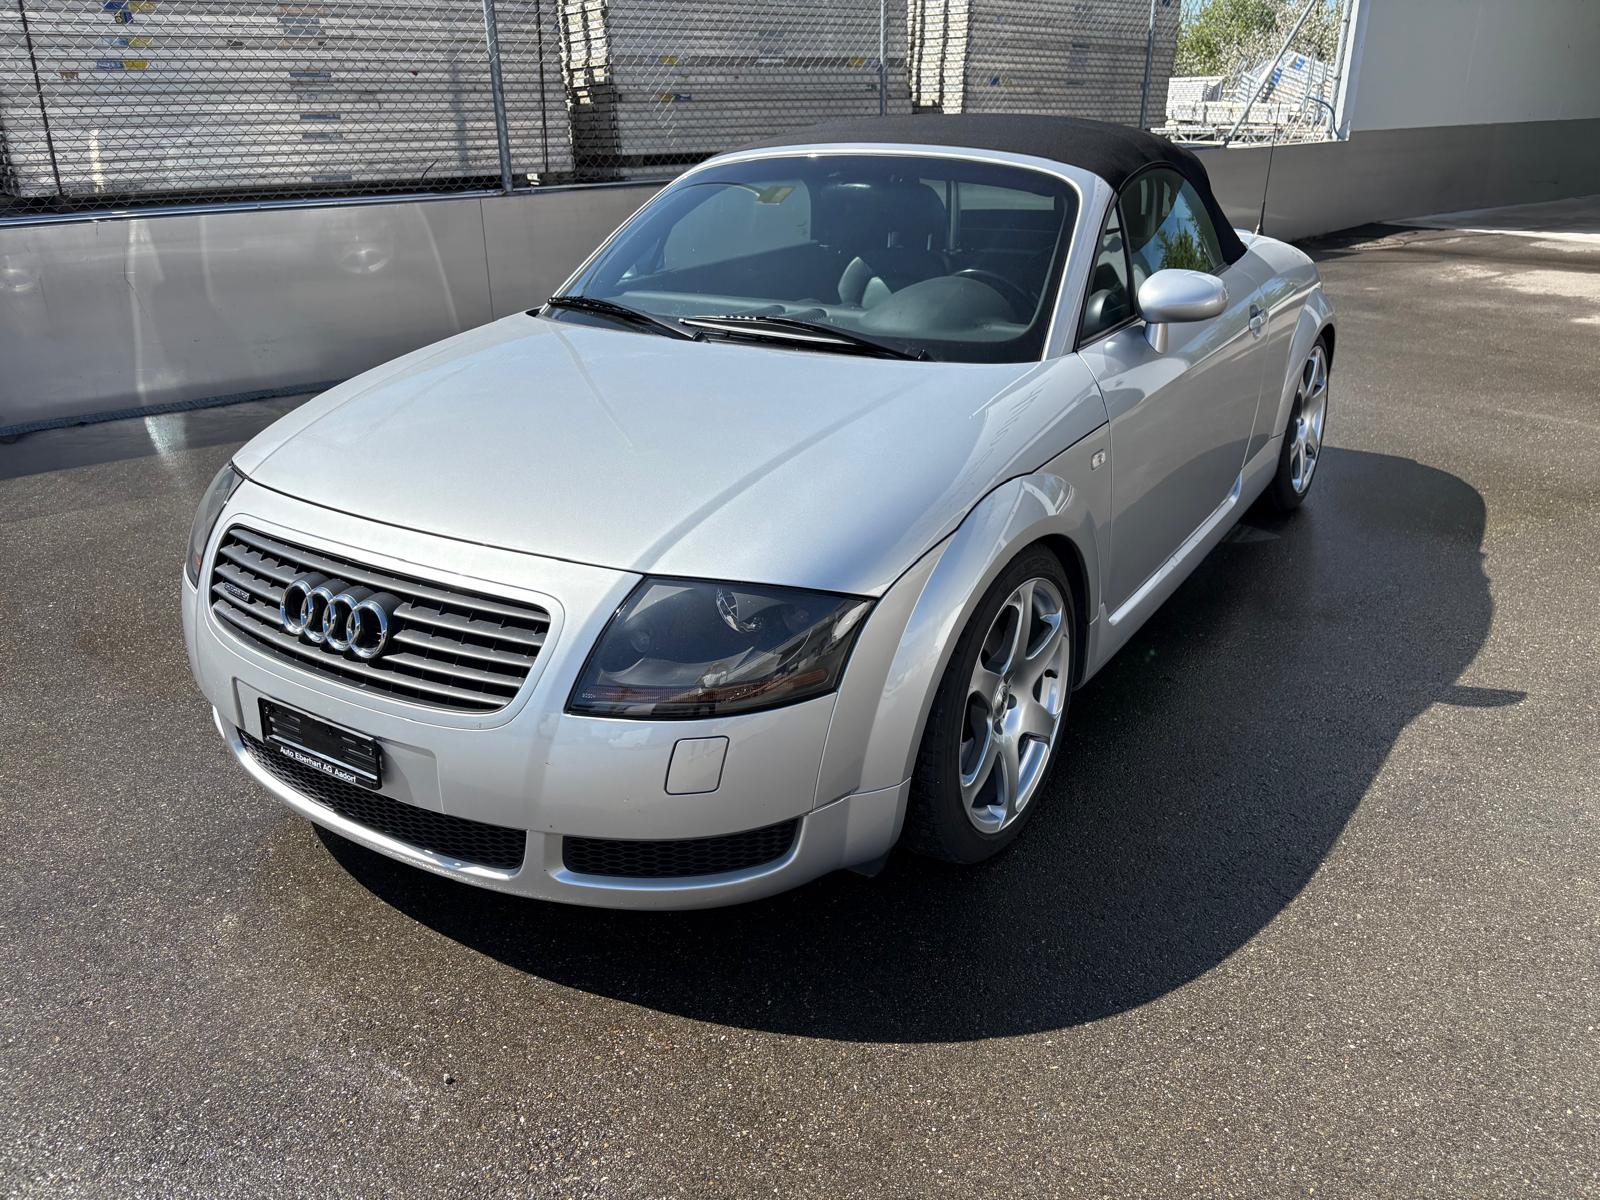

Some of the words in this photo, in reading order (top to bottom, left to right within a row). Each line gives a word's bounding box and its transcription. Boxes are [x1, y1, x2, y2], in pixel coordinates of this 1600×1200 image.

[280, 746, 294, 757] Auto
[295, 752, 322, 769] Eberhart
[334, 768, 357, 783] Aadorf
